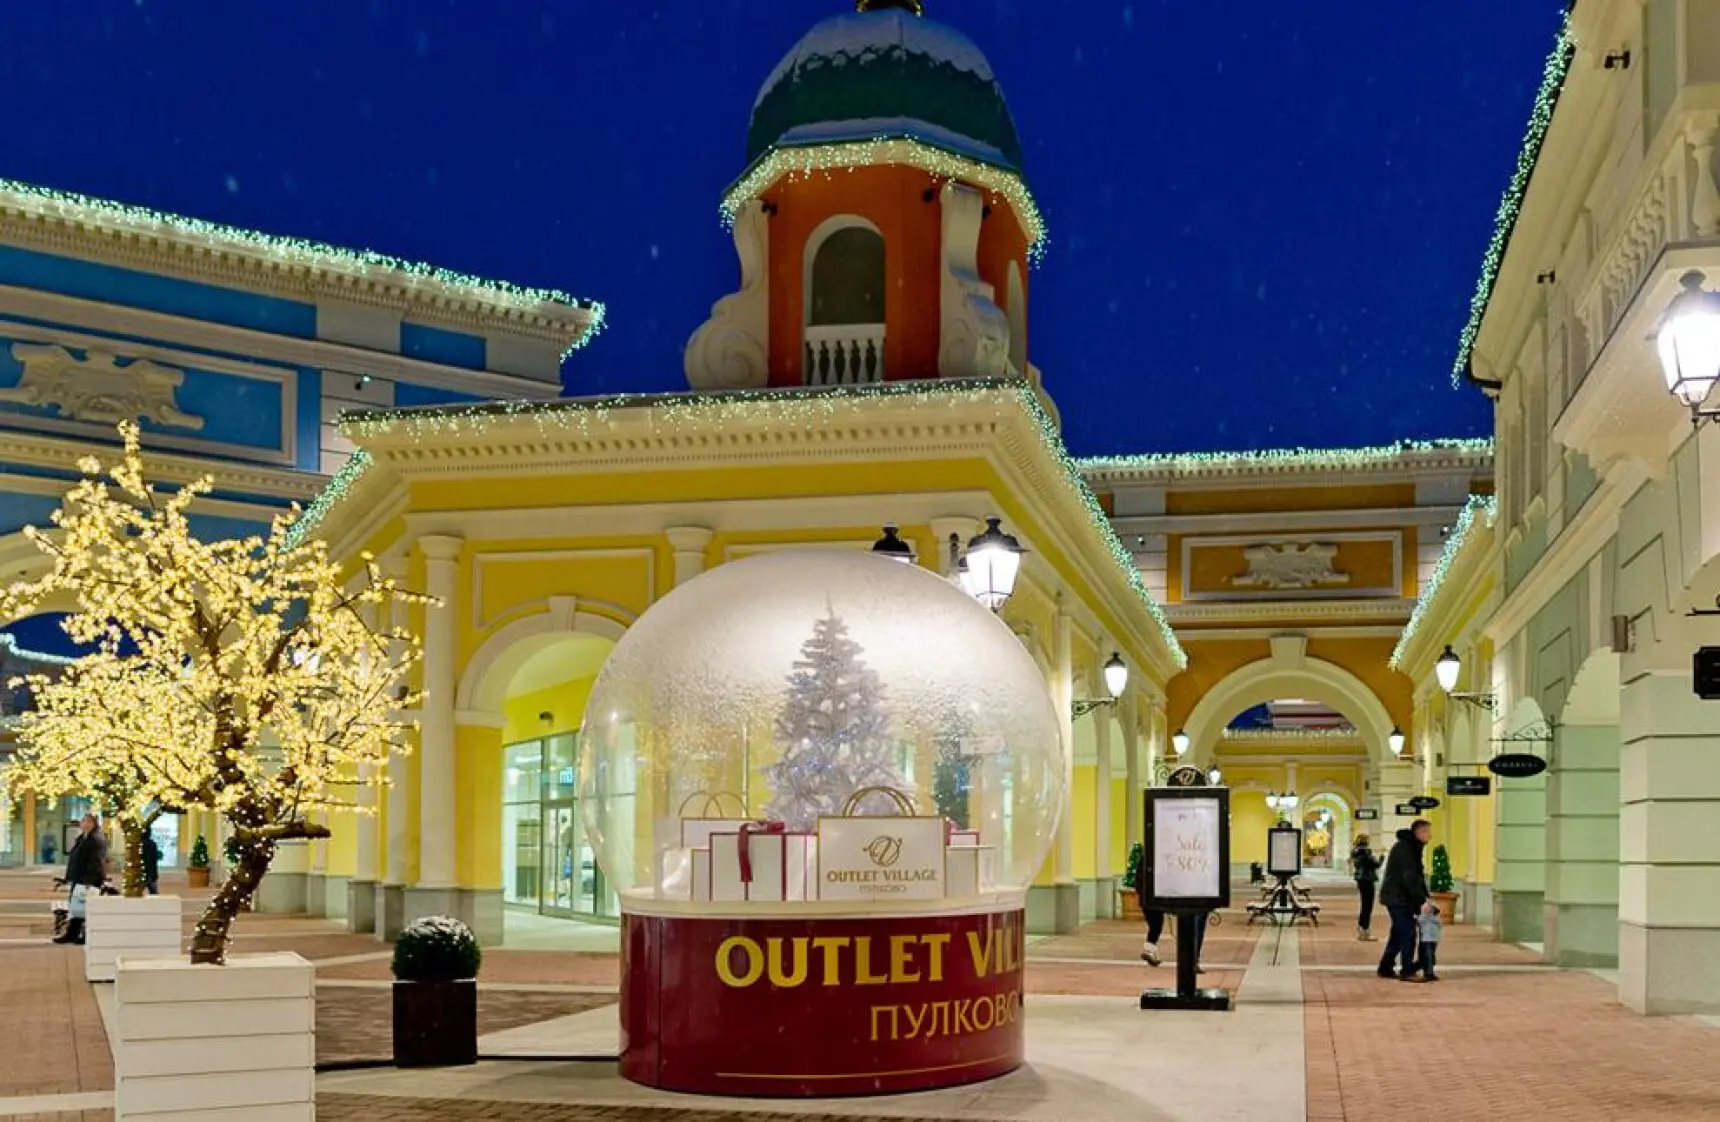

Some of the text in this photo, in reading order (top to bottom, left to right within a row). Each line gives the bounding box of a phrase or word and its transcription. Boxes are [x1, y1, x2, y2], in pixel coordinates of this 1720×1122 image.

[826, 868, 939, 882] OUTLET VILLAGE
[715, 934, 951, 988] OUTLET
[870, 990, 1018, 1041] ПУЛКОВО
